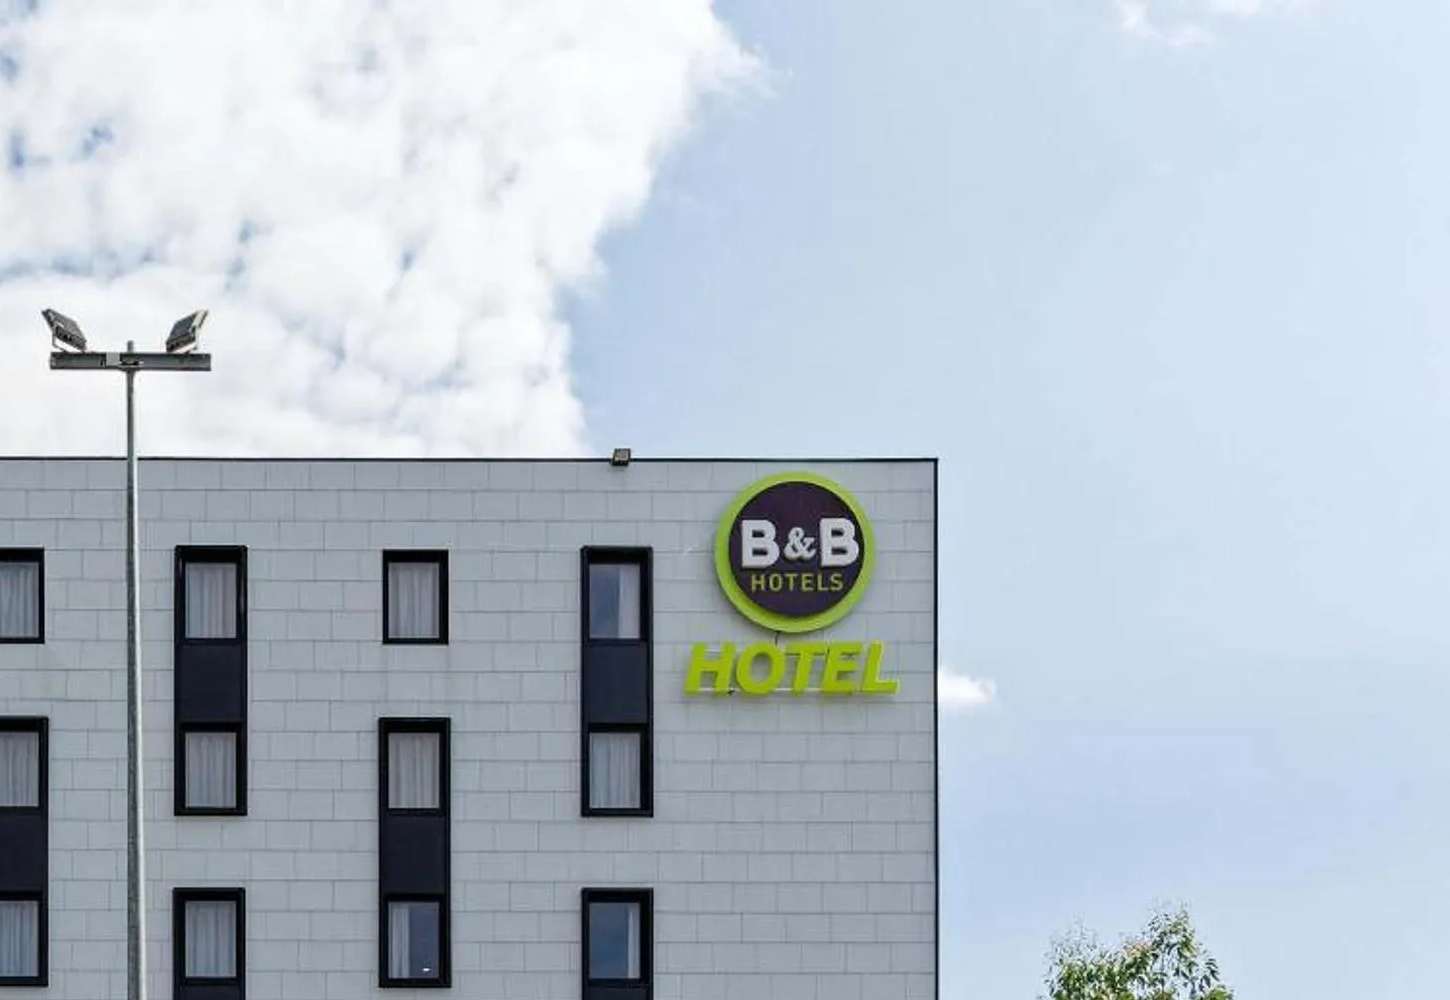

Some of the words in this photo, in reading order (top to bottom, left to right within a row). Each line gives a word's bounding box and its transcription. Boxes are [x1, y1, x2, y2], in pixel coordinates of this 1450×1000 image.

[741, 518, 859, 569] B&B
[751, 573, 844, 592] HOTELS
[684, 641, 899, 695] HOTEL
